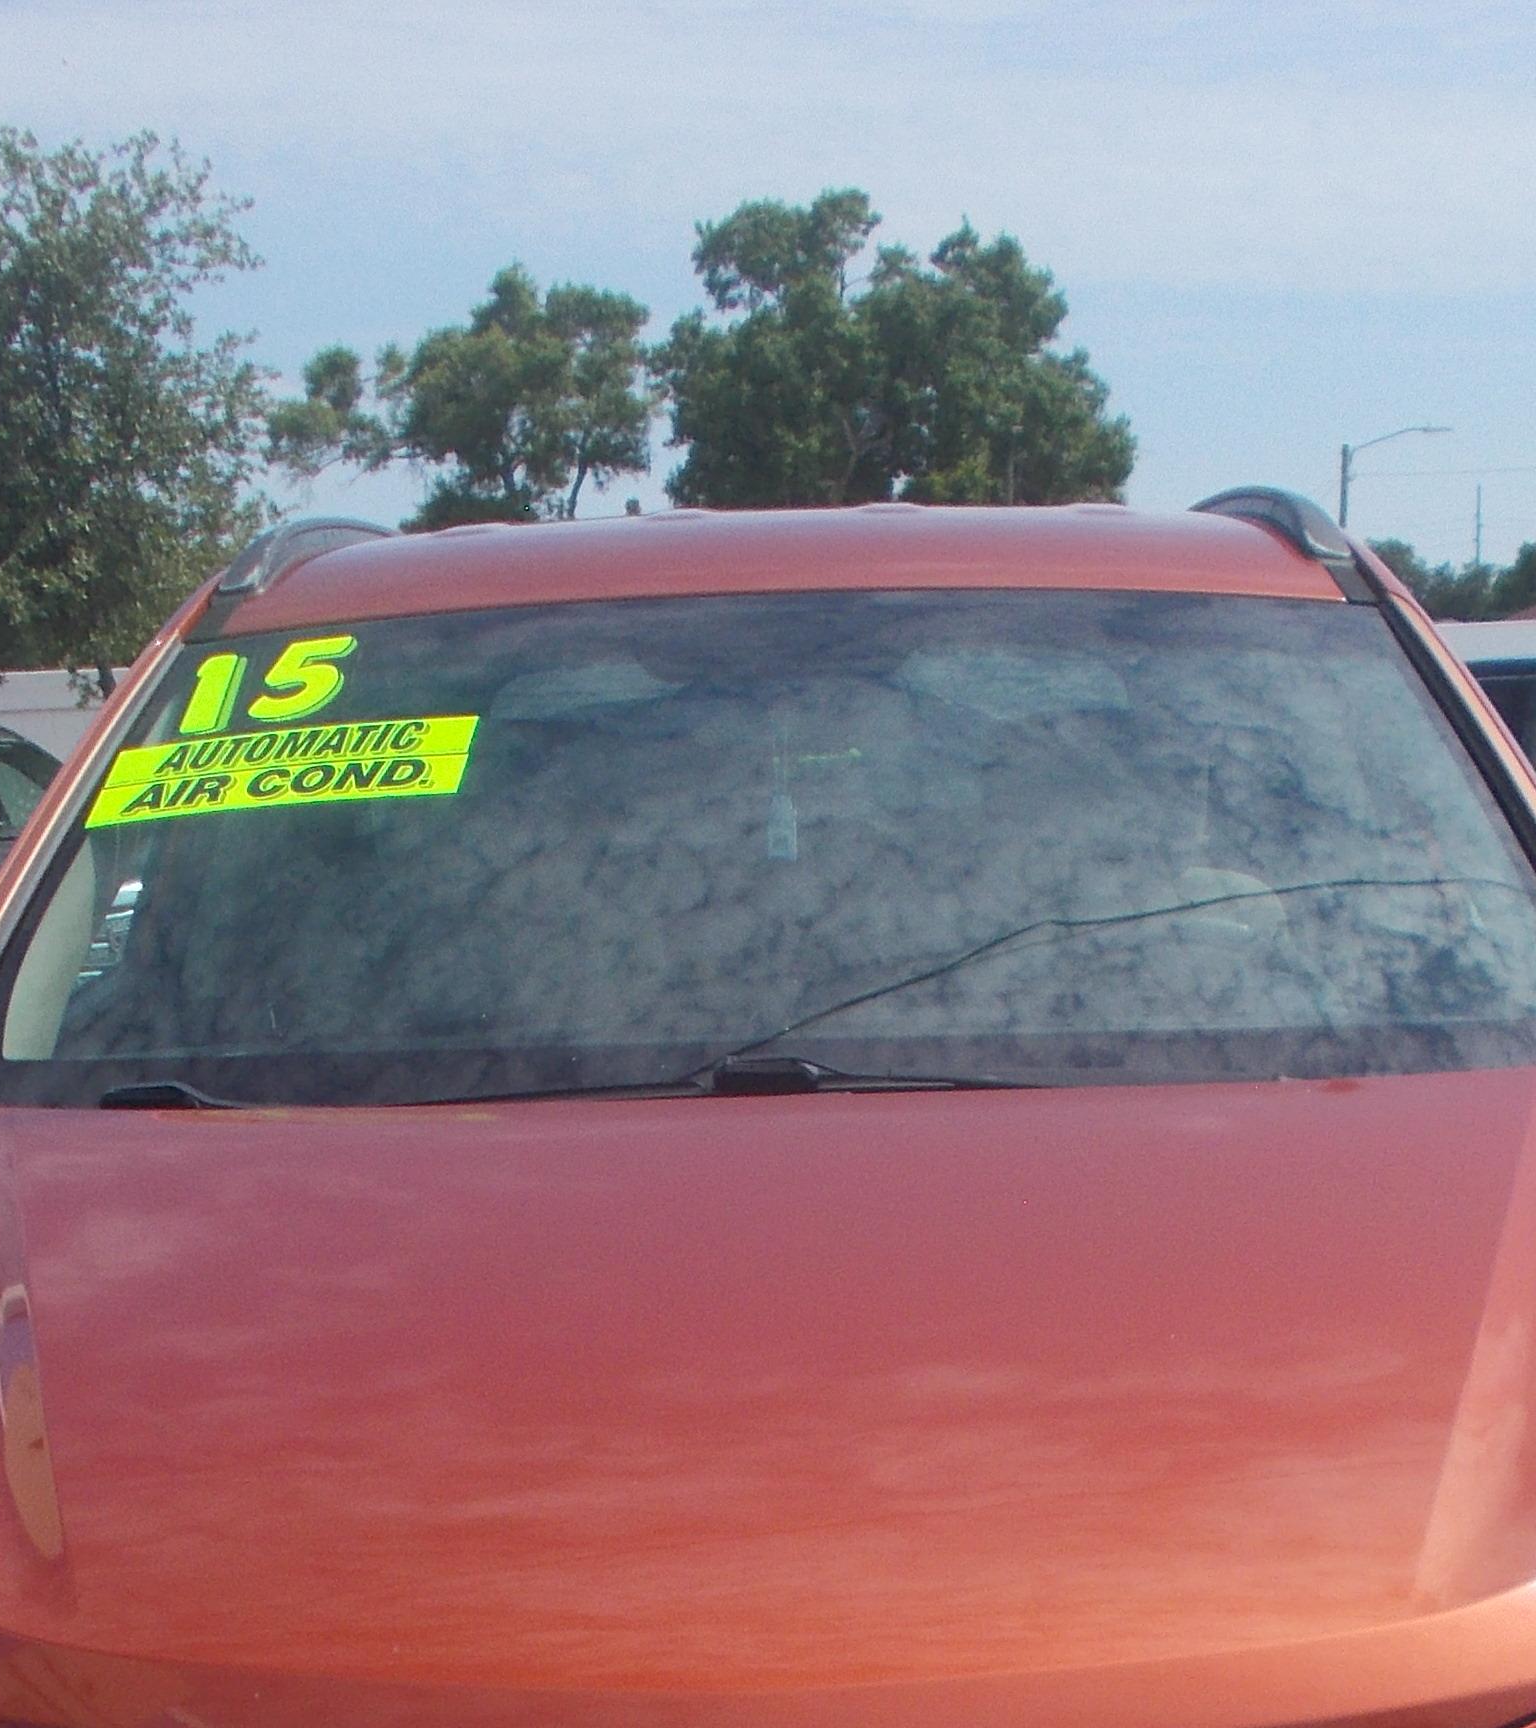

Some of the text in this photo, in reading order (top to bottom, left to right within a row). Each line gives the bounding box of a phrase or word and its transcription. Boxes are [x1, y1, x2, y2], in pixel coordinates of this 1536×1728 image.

[180, 635, 358, 734] 15
[154, 720, 431, 777] AUTOMATIC
[120, 758, 436, 817] AIR COND.
